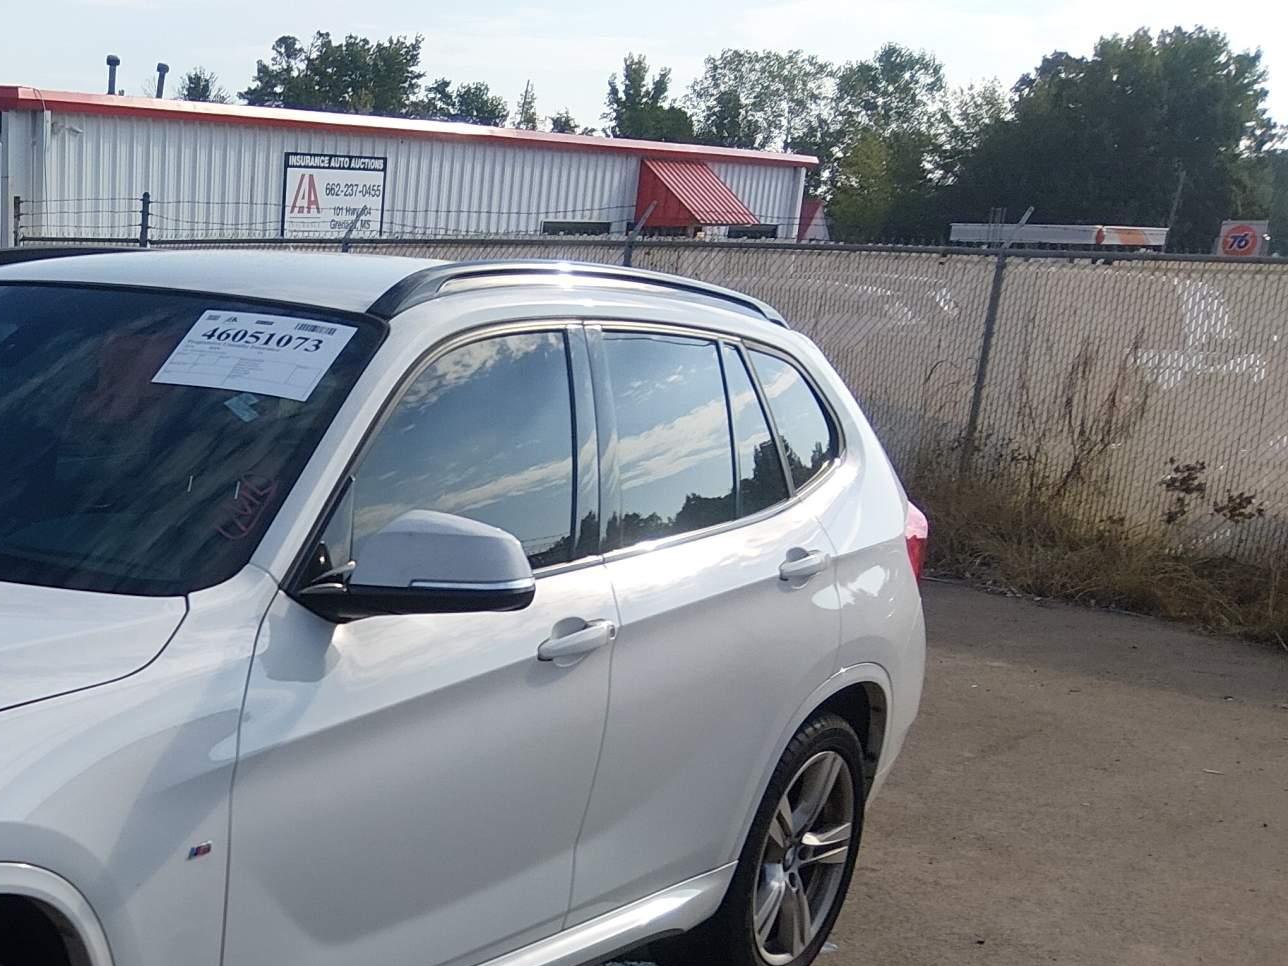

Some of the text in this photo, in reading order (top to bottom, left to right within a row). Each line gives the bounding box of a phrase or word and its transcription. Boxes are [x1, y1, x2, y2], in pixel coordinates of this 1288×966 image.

[289, 155, 384, 170] INSURANCE AUTO AUCTIONS
[325, 183, 381, 197] 662-237-0455
[1228, 231, 1250, 250] 76
[201, 327, 324, 353] 46051073
